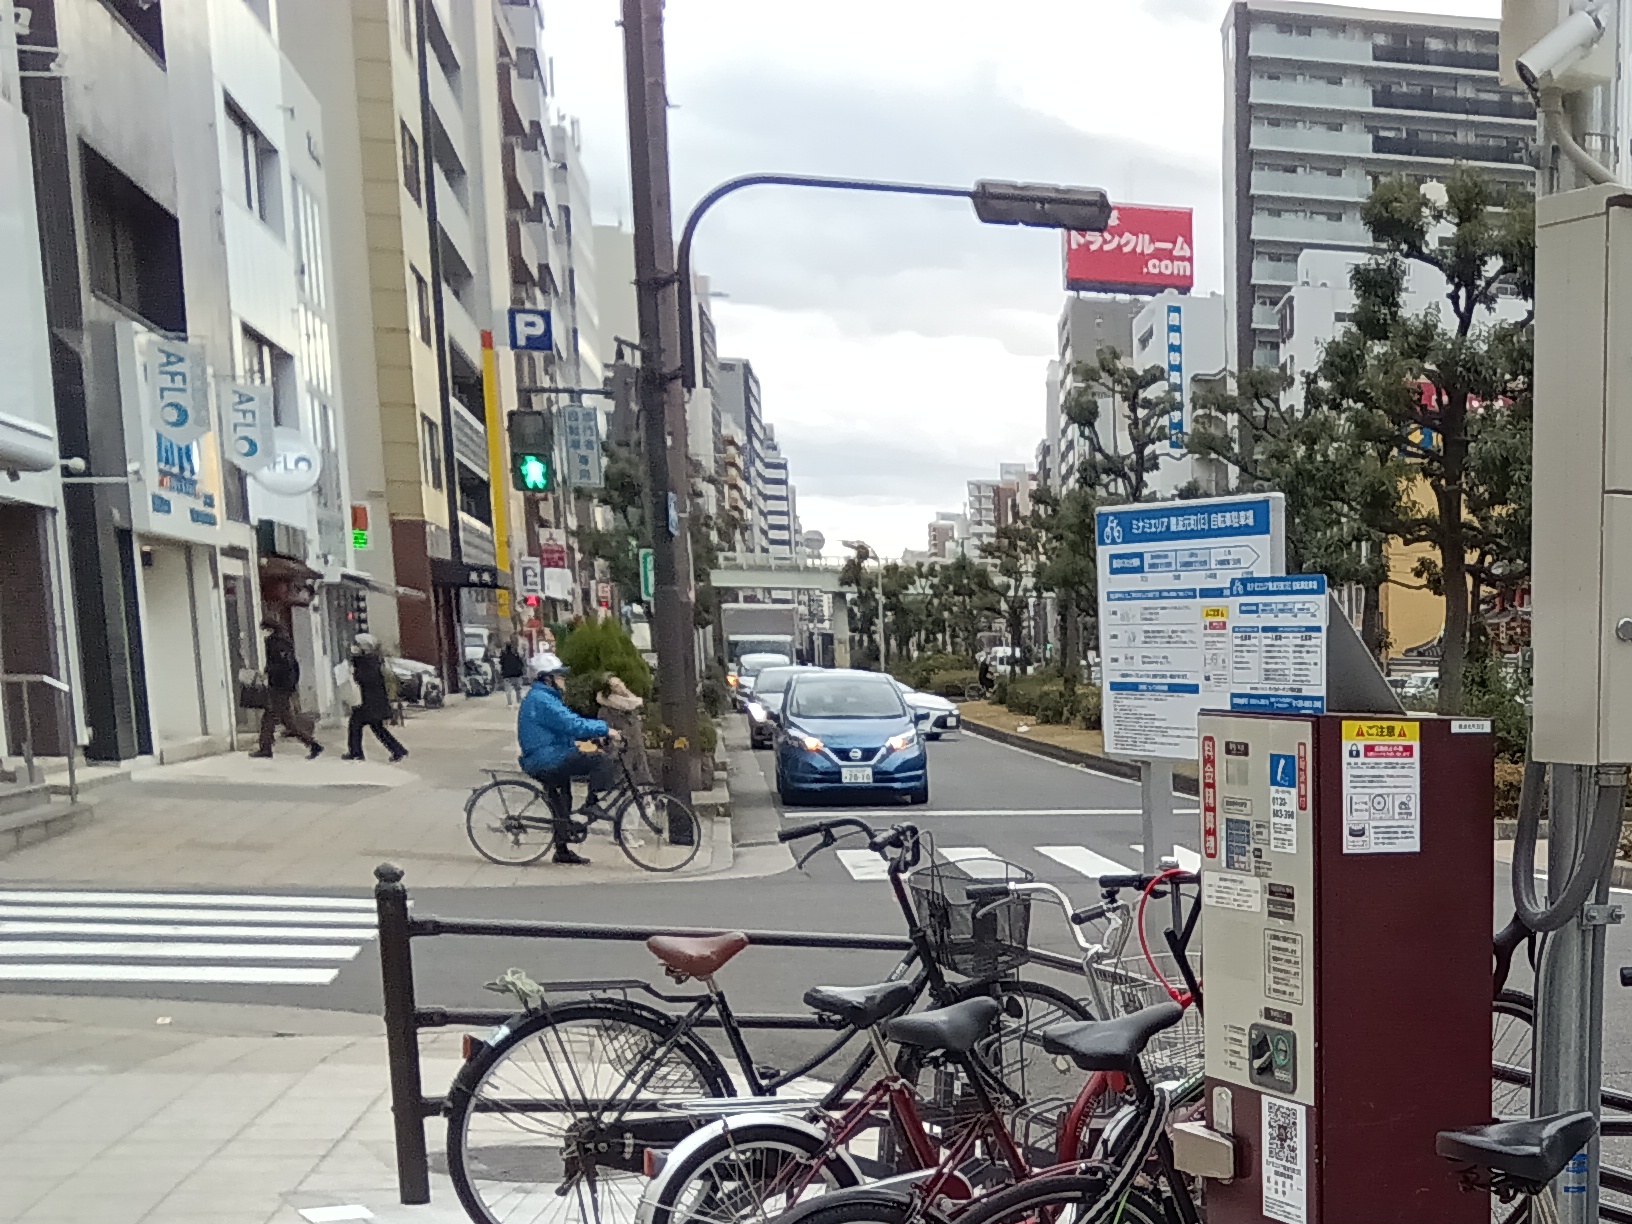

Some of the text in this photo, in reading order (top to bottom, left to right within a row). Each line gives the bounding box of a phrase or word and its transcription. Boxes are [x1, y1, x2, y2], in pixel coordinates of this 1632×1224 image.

[1070, 231, 1191, 258] トランクルーム
[1142, 258, 1191, 276] .com
[514, 312, 546, 346] P
[157, 346, 190, 428] AFLO
[231, 388, 259, 458] AFLO
[266, 453, 313, 473] FLO
[1365, 724, 1396, 738] ご注意
